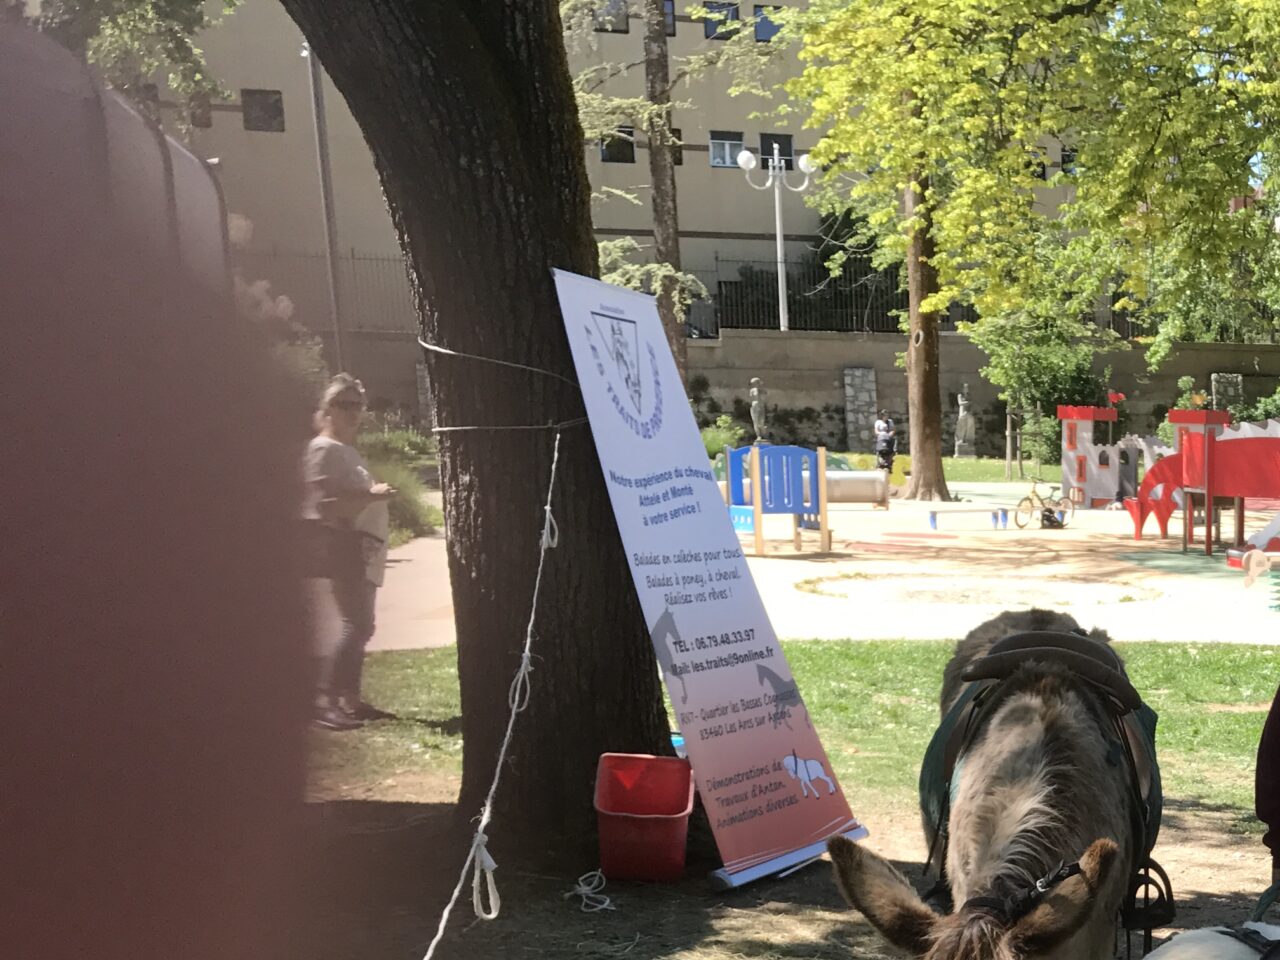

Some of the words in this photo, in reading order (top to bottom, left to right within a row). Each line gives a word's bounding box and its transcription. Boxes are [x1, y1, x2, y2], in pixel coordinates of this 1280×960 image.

[609, 470, 633, 488] Notre
[635, 470, 673, 490] expérience
[674, 466, 683, 478] du
[685, 466, 713, 482] cheval
[662, 490, 670, 502] et
[670, 484, 693, 499] Monté
[643, 514, 648, 526] à
[649, 512, 668, 525] votre
[669, 504, 696, 519] service
[633, 552, 660, 567] Balades
[662, 555, 672, 564] en
[704, 551, 721, 566] pour
[646, 573, 673, 589] Balades
[675, 572, 680, 586] à
[707, 569, 713, 582] à
[664, 591, 693, 605] Réalisez
[694, 592, 707, 602] vos
[708, 587, 728, 601] rêves
[672, 640, 690, 654] TEL
[695, 628, 755, 650] 06.79.48.33.97
[729, 700, 739, 713] les
[725, 722, 737, 734] Les
[756, 716, 765, 727] sur
[706, 765, 770, 792] Démonstrations
[772, 760, 782, 772] de
[716, 791, 749, 808] Travaux
[717, 806, 764, 829] Animations
